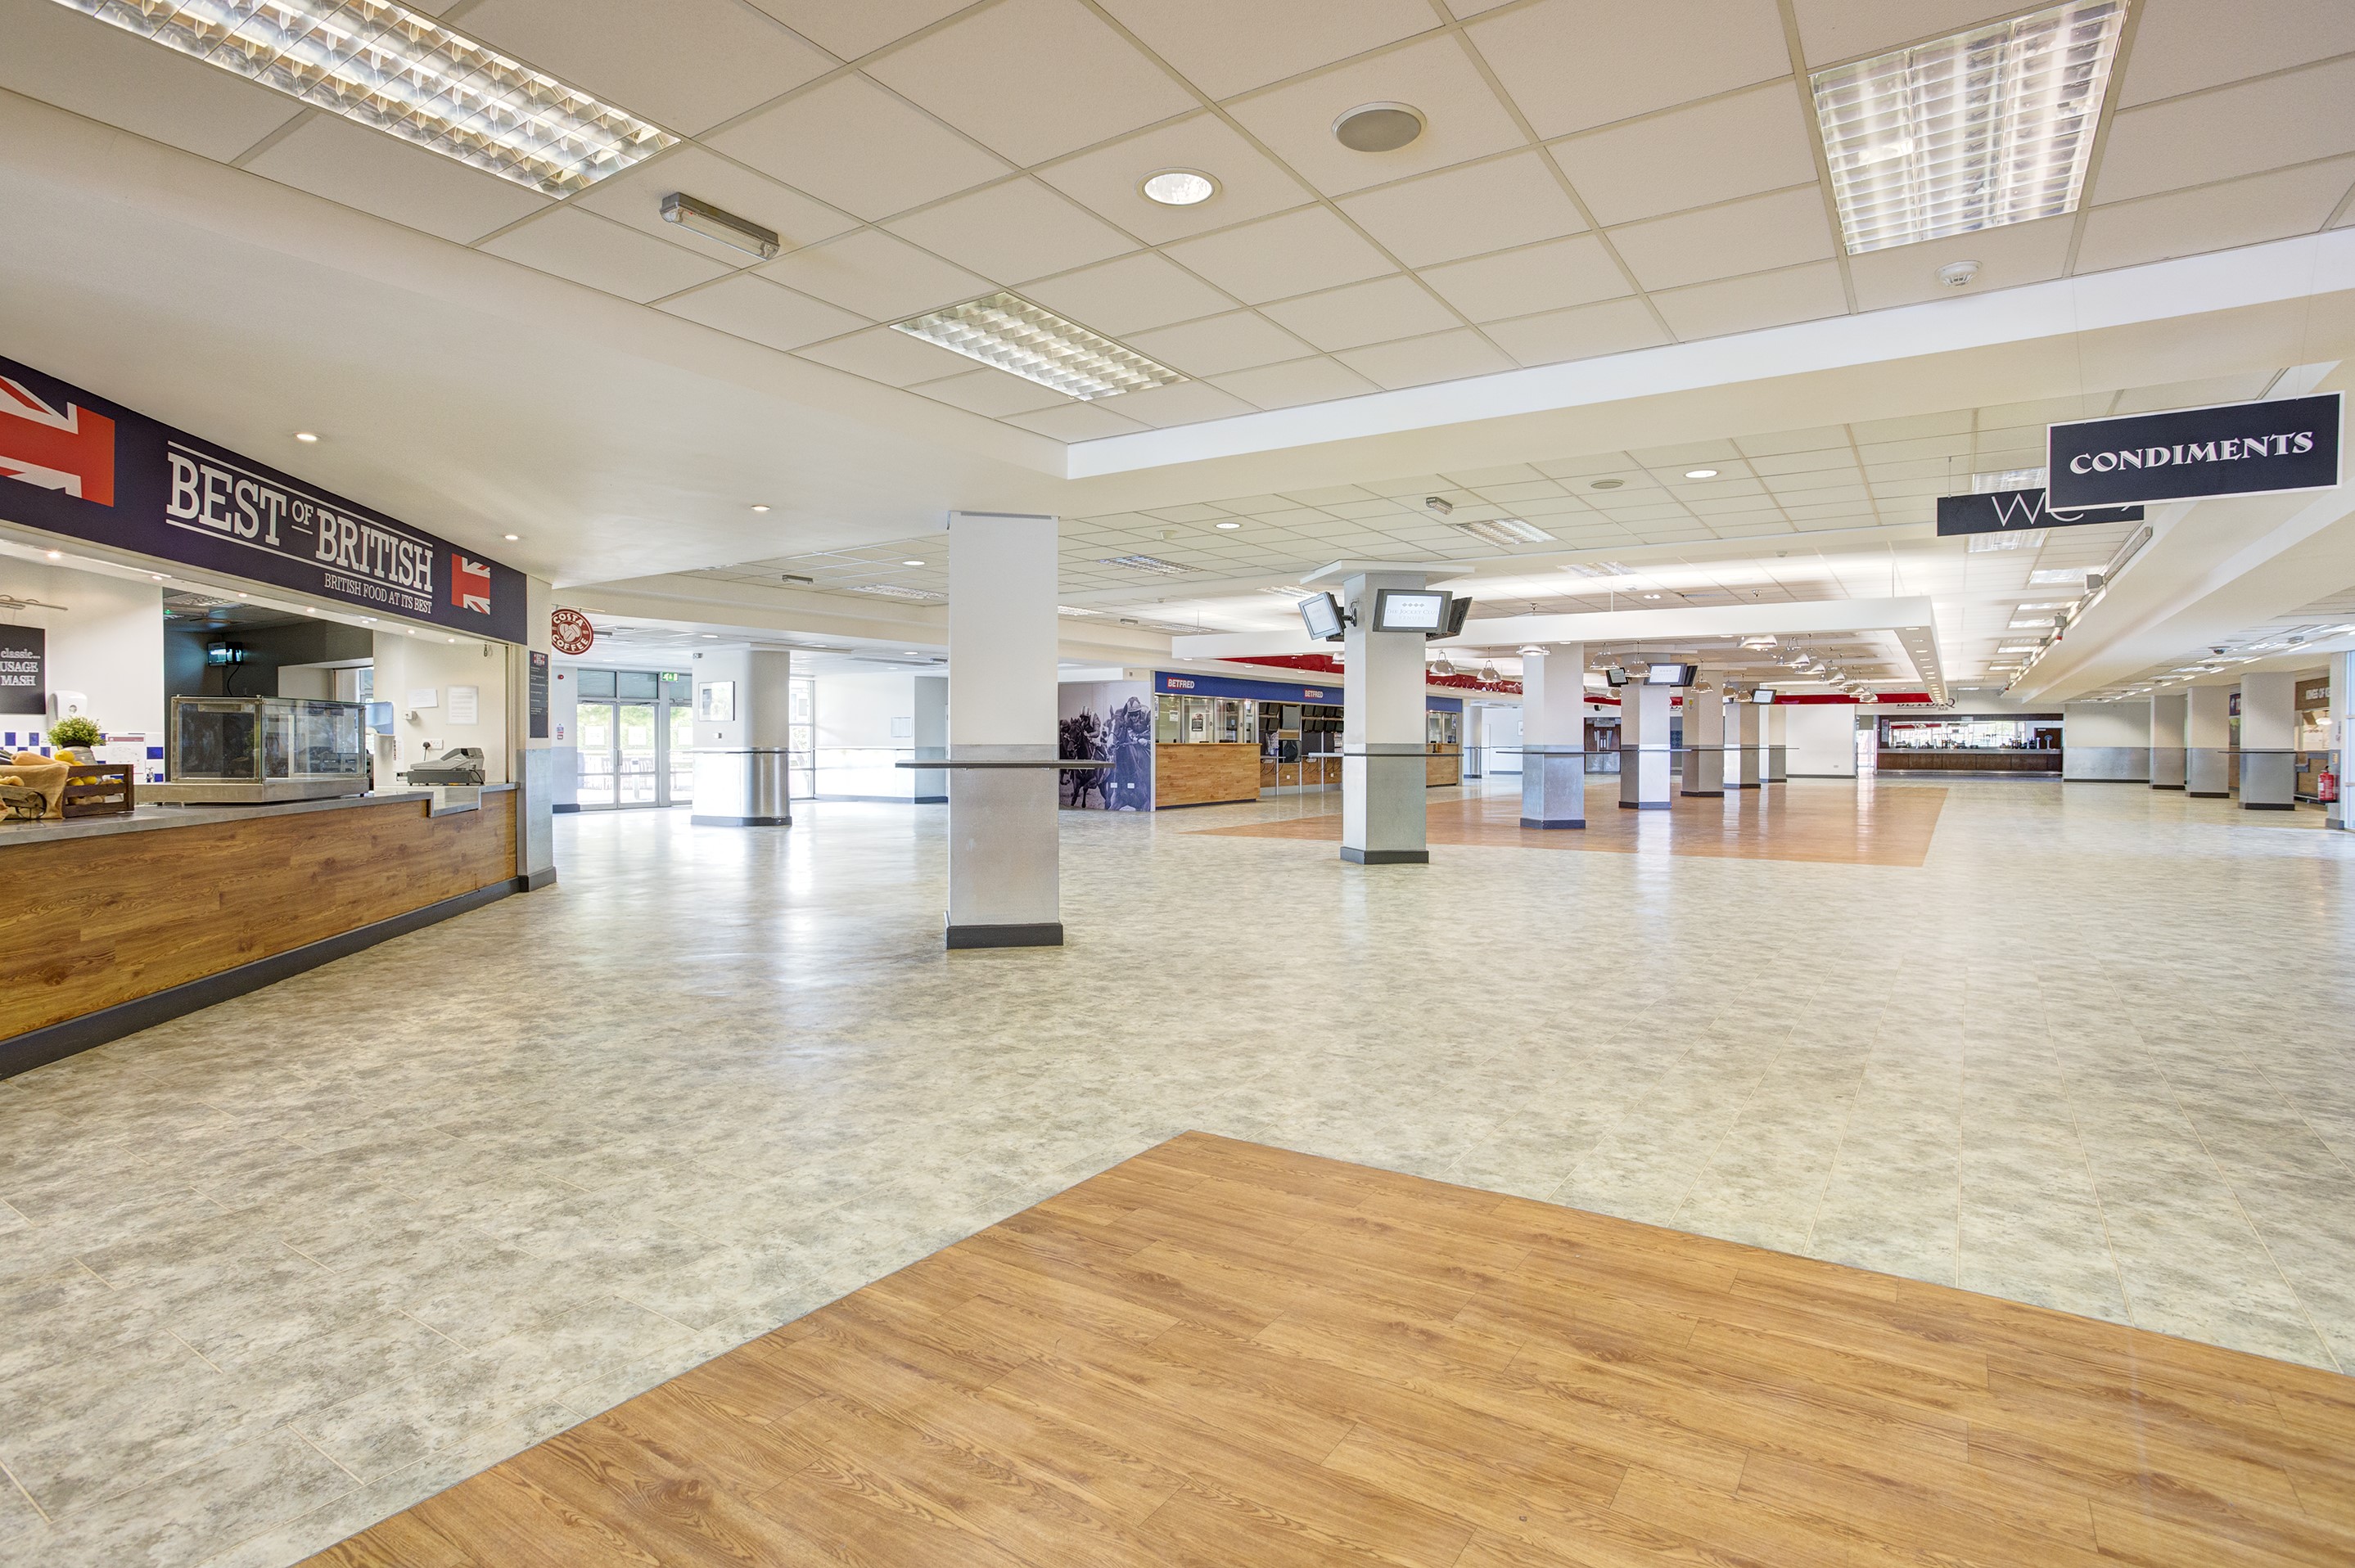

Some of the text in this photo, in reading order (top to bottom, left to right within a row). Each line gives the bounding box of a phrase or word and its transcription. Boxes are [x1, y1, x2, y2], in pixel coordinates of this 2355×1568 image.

[2069, 430, 2314, 475] CONDIMENTS
[166, 451, 433, 593] BEST OF BRITISH
[323, 573, 432, 614] BRITISH FOOD AT ITS BEST
[553, 613, 584, 627] COSTA
[552, 634, 589, 651] COFFEE
[0, 675, 36, 686] MASH
[1167, 678, 1195, 689] BETFRED
[1304, 689, 1324, 699] BETFRED
